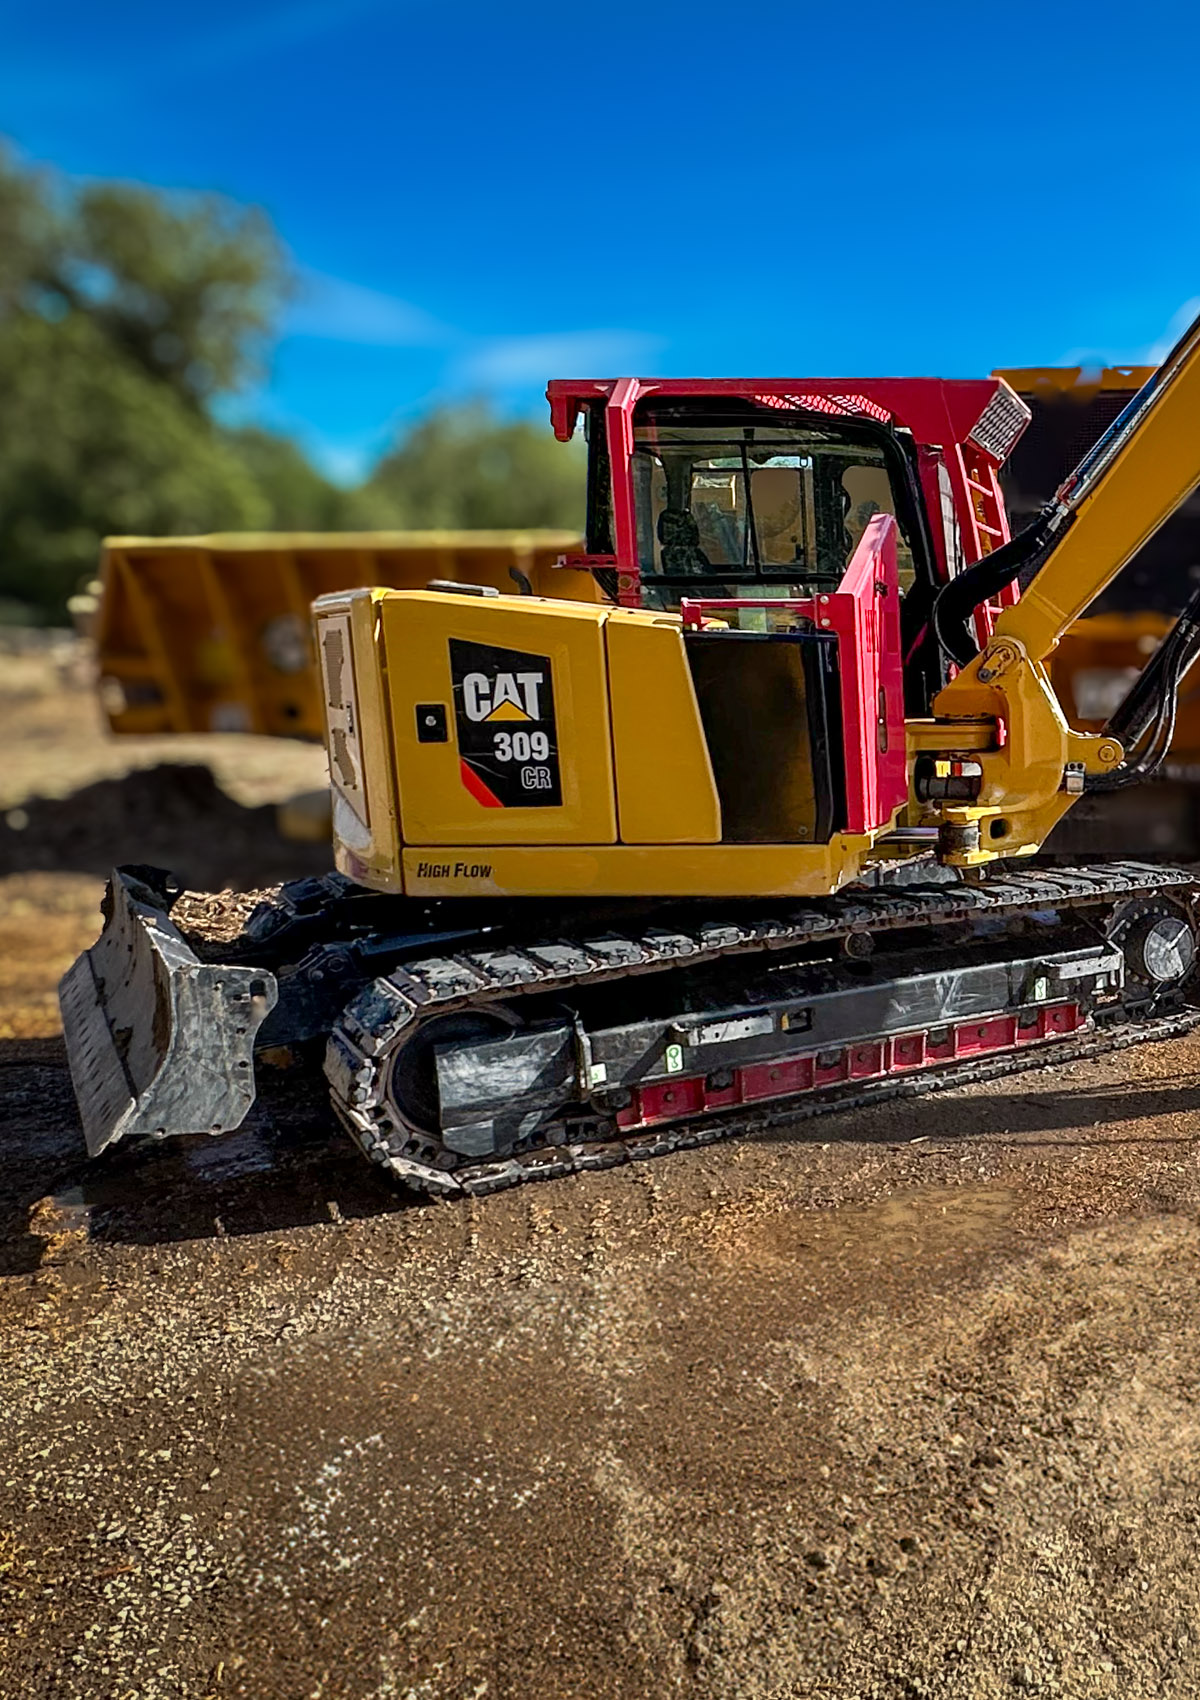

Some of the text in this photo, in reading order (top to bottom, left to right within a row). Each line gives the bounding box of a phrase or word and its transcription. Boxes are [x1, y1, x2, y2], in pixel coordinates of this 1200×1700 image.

[463, 672, 543, 722] CAT
[493, 731, 549, 761] 309
[520, 766, 552, 789] CR
[417, 862, 492, 878] HIGH FLOW
